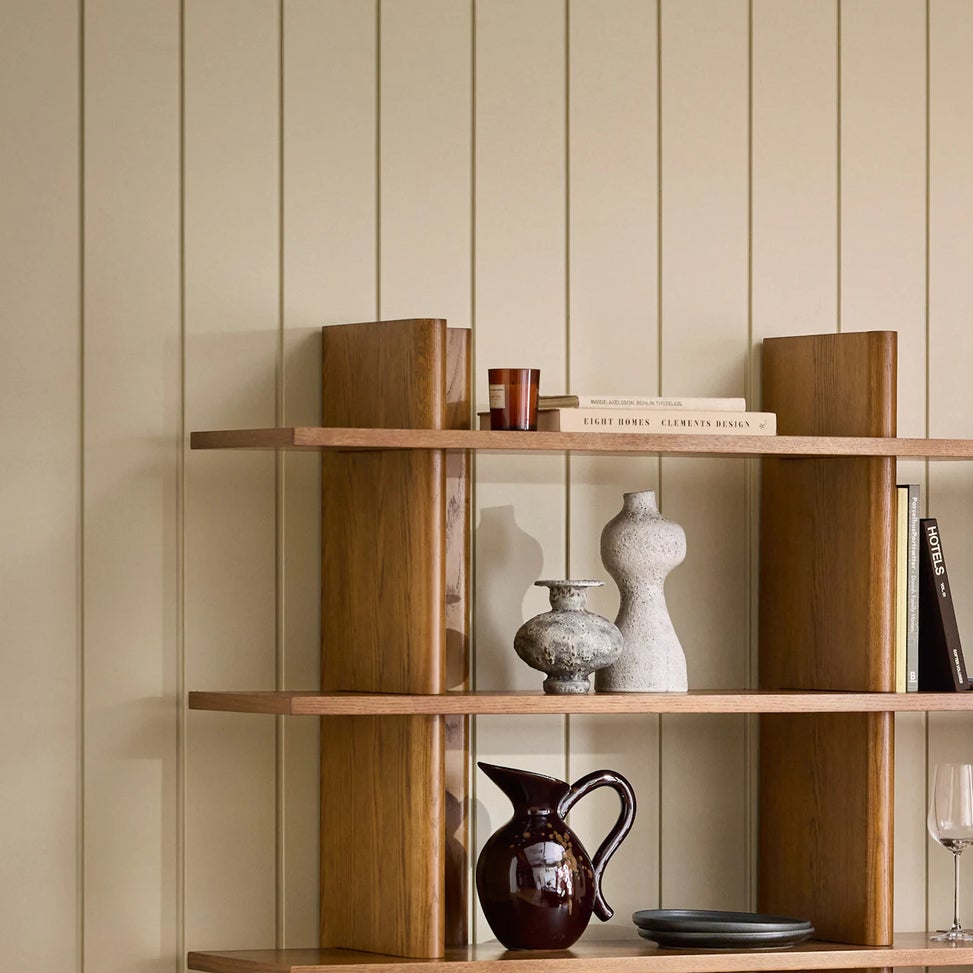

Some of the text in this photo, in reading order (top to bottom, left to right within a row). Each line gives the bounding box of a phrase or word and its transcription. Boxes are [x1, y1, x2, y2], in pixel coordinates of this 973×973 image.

[583, 417, 613, 426] EIGHT
[618, 418, 650, 427] HOMES
[661, 419, 711, 428] CLEMENTS
[716, 420, 750, 428] DESIGN
[927, 525, 945, 576] HOTELS
